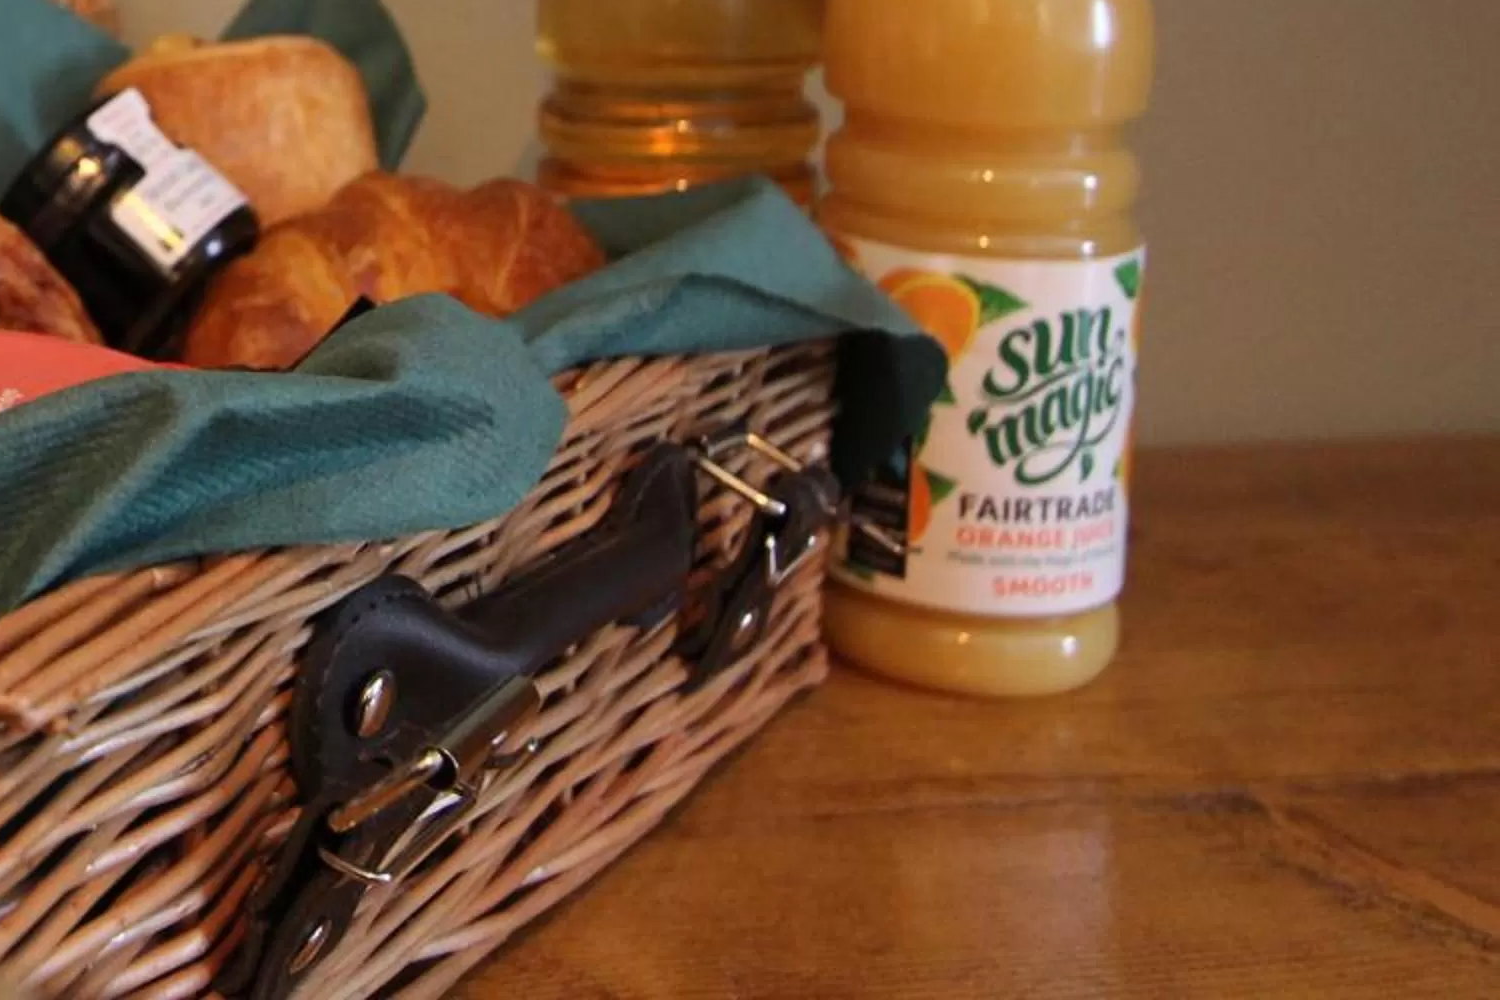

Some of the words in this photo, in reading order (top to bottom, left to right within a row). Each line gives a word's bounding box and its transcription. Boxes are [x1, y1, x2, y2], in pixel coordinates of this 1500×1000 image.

[958, 487, 1115, 523] FAIRTRADE
[955, 527, 1063, 548] ORANGE
[993, 572, 1093, 597] SMOOTH
